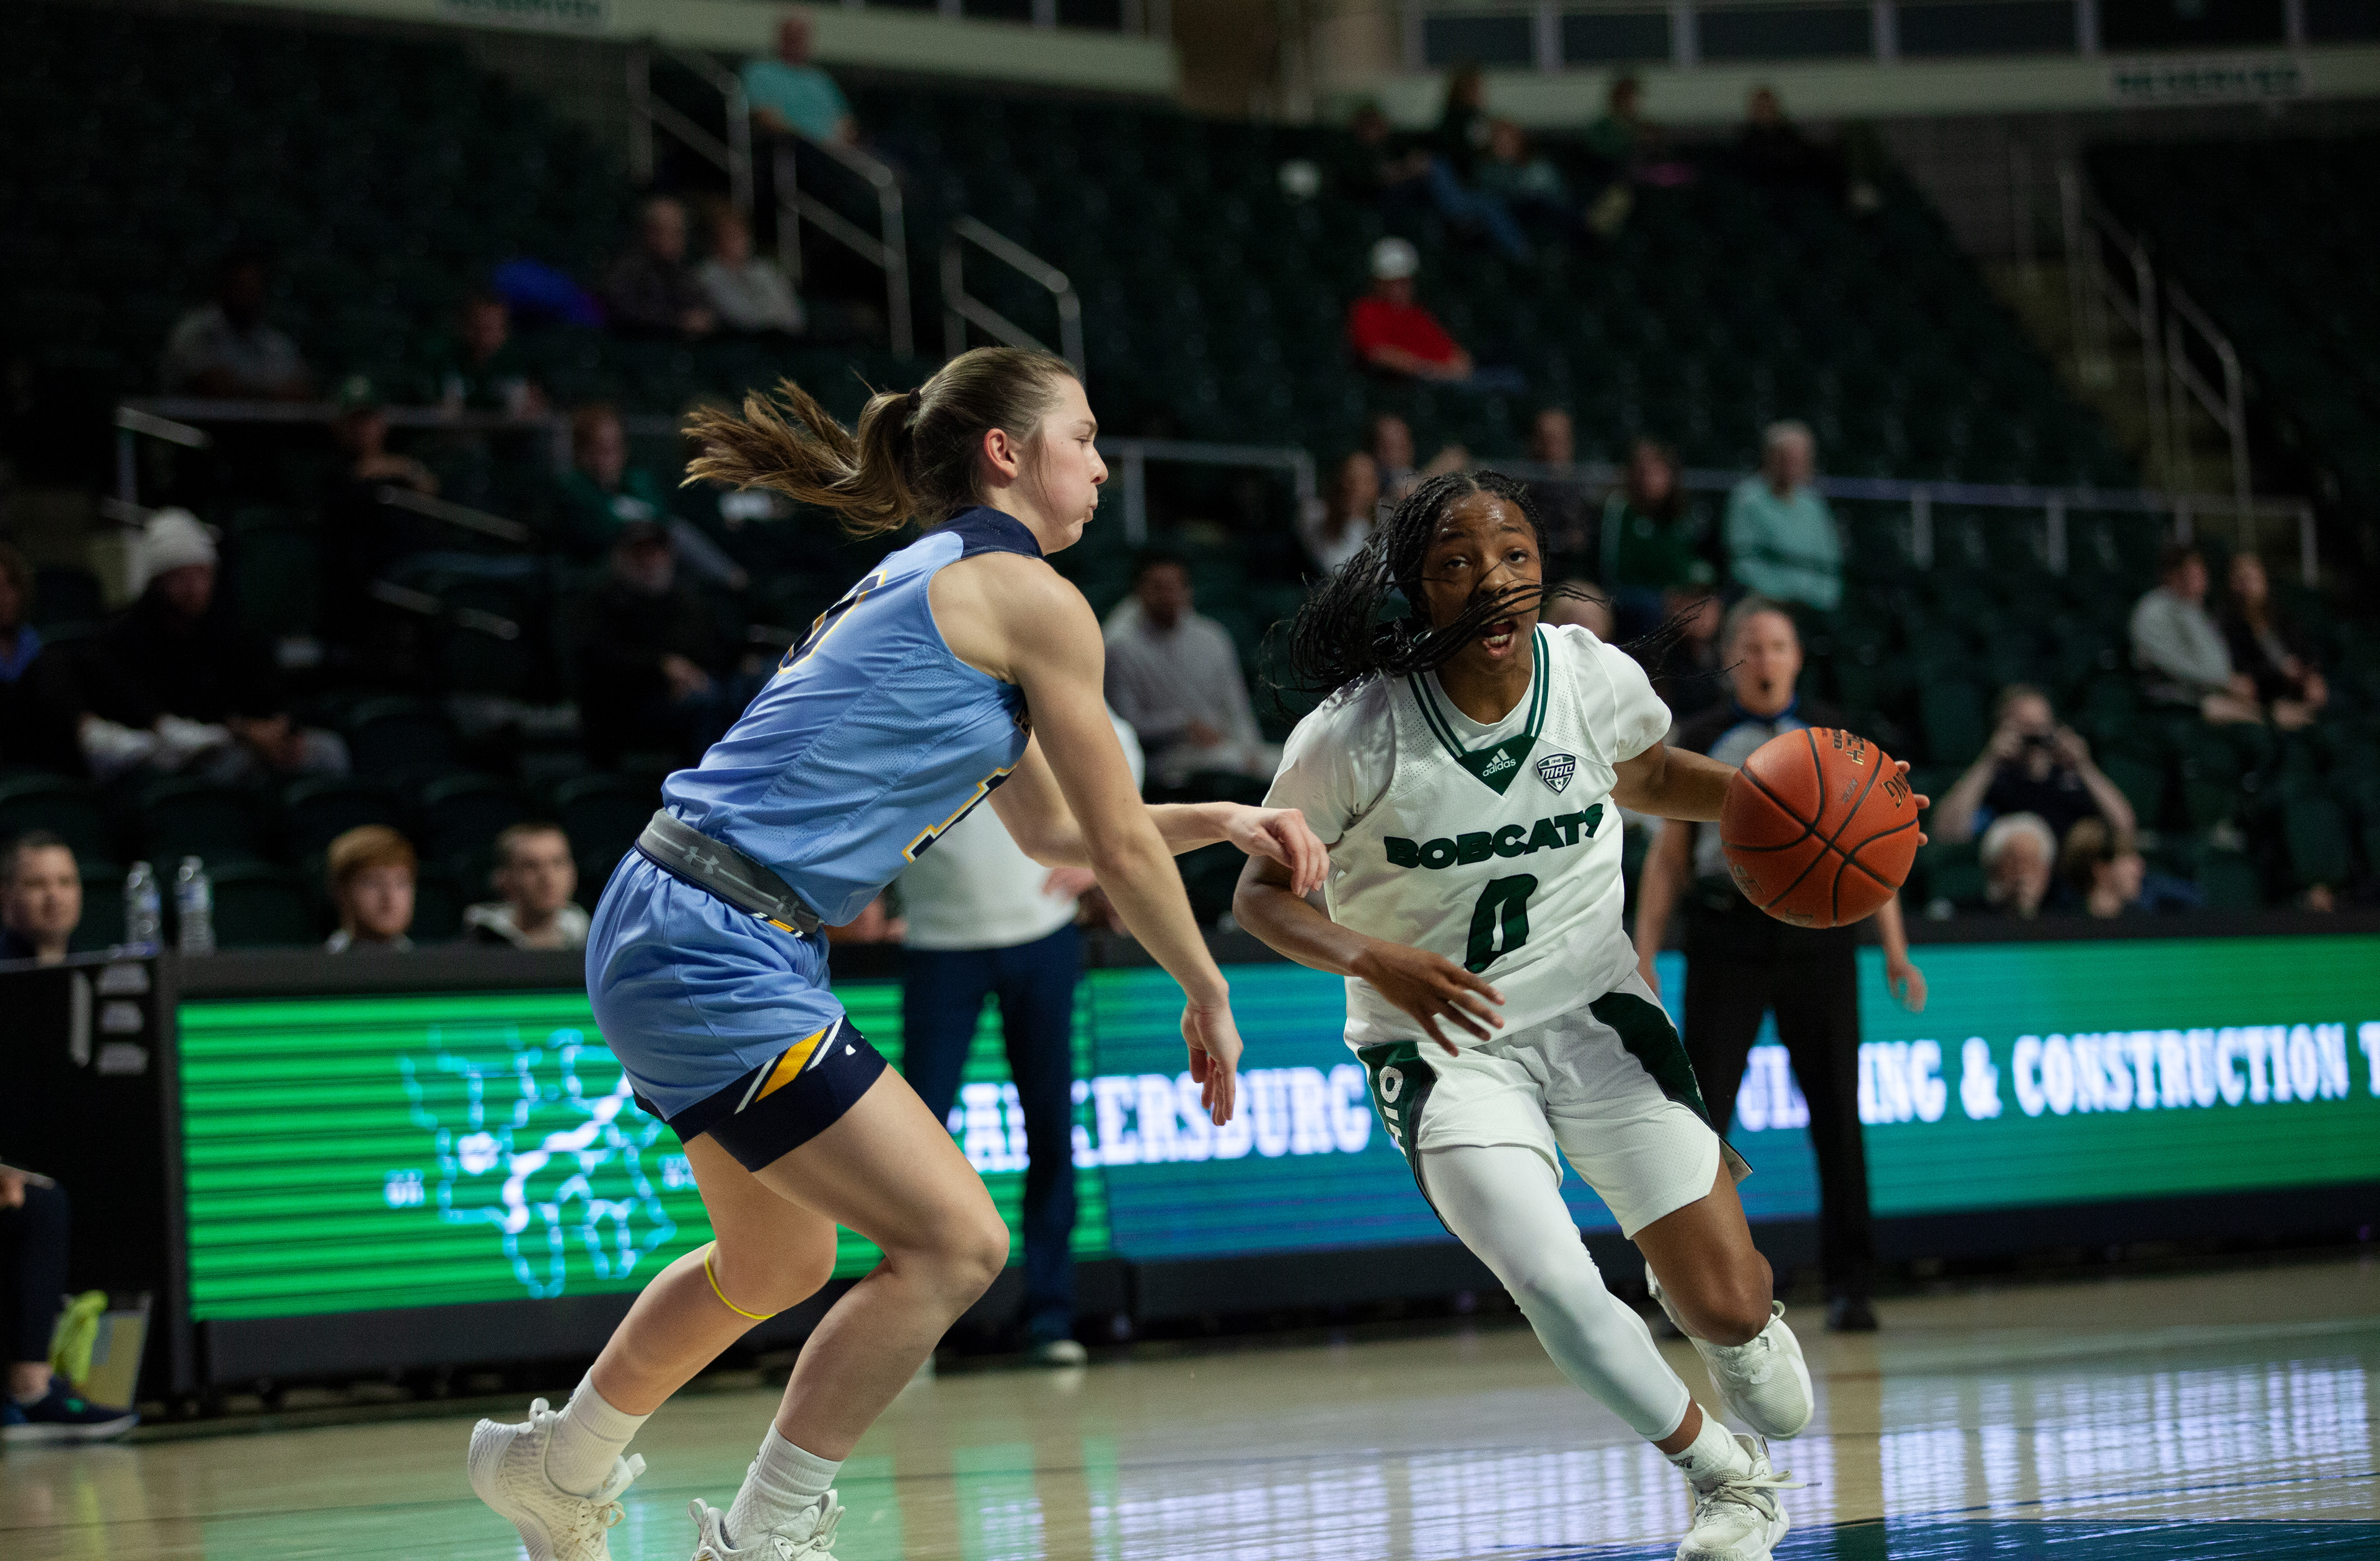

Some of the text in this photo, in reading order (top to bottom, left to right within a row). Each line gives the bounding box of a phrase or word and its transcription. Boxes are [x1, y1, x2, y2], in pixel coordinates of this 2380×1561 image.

[1482, 758, 1517, 777] adidas
[1541, 764, 1574, 779] MAC
[1384, 803, 1604, 870] BOBCATS
[1464, 873, 1539, 974] 0
[946, 1063, 1373, 1174] AERSBURG
[1960, 1037, 2003, 1120] &
[2012, 1022, 2351, 1117] CONSTRUCTION
[1378, 1065, 1407, 1157] HIO
